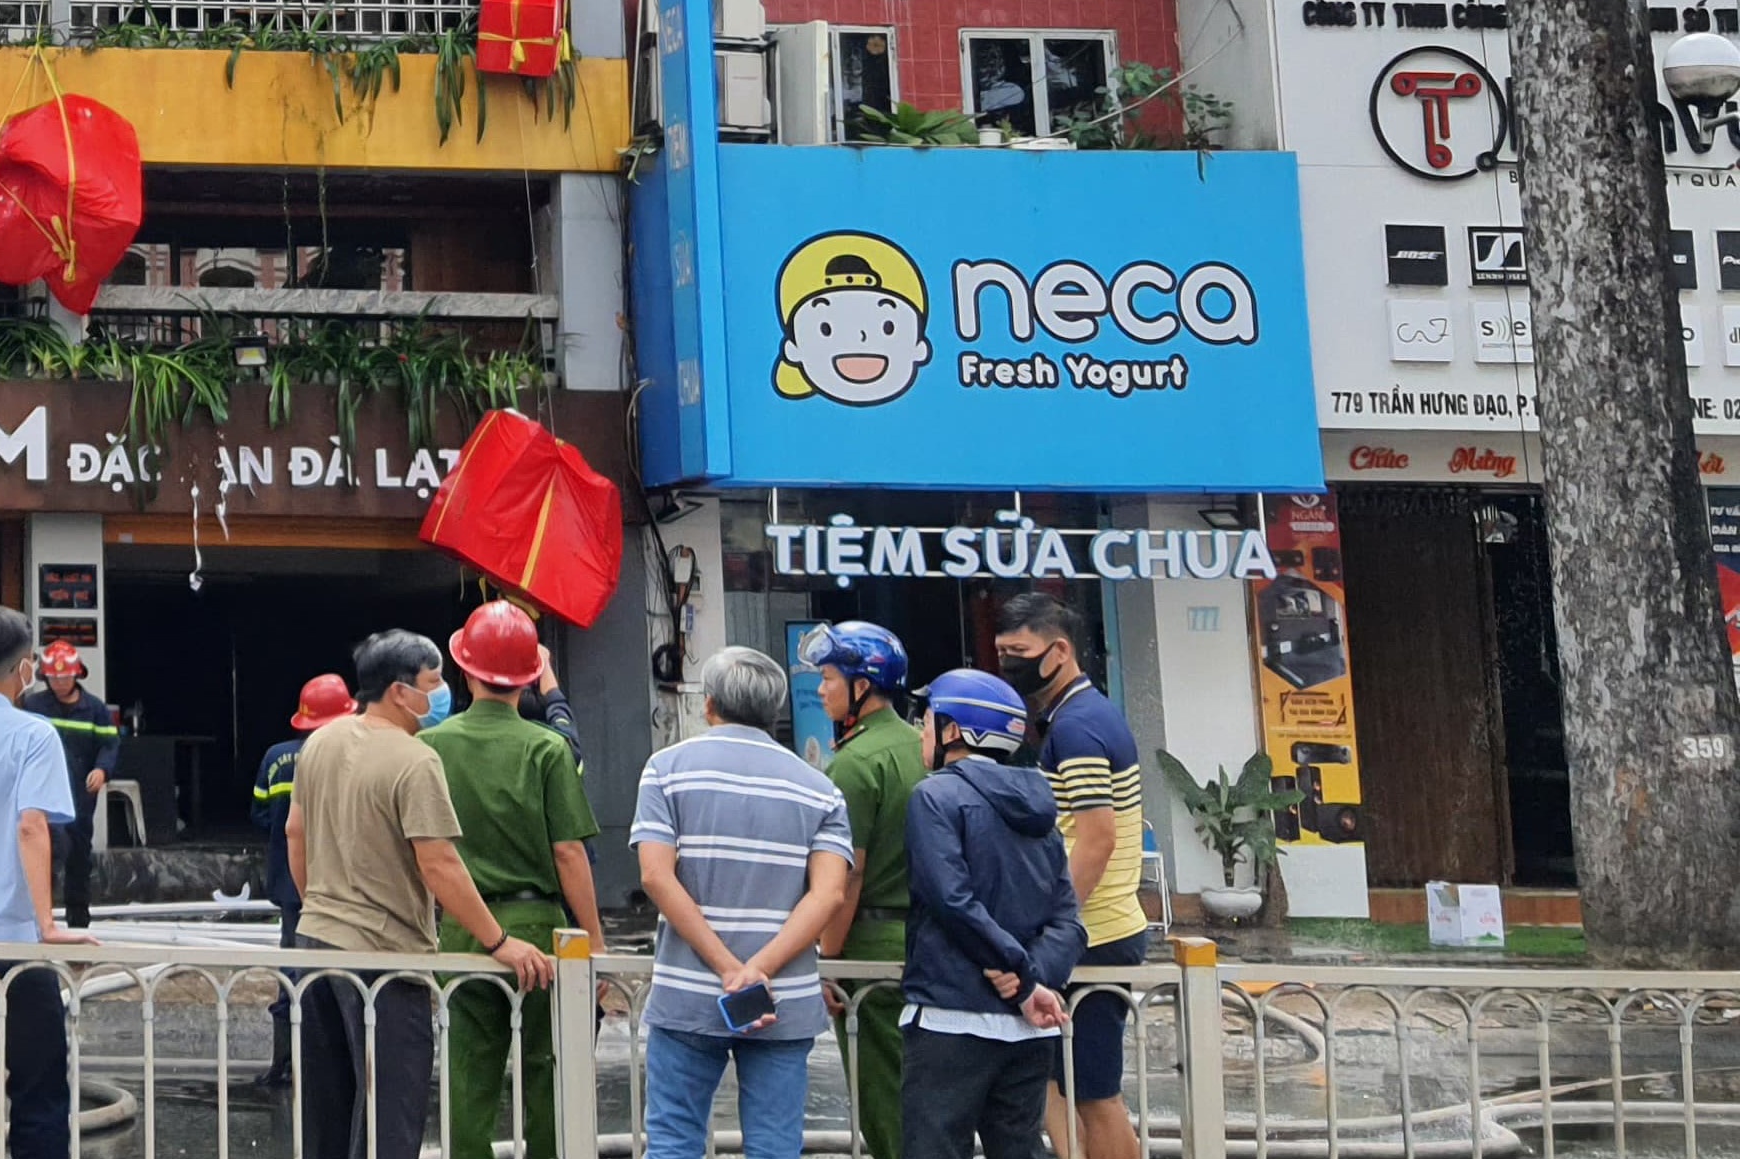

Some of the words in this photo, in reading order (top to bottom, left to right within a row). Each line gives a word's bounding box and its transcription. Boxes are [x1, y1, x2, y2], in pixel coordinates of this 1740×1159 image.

[952, 258, 1258, 345] neca
[958, 351, 1059, 388] Fresh
[1063, 352, 1189, 398] Yogurt
[1332, 392, 1364, 414] 779
[1368, 384, 1414, 415] TRẦN
[1421, 391, 1469, 416] HƯNG
[765, 513, 926, 589] TIỆM
[942, 510, 1079, 579] SỮA
[1090, 528, 1279, 580] CHUA
[1682, 736, 1724, 759] 359
